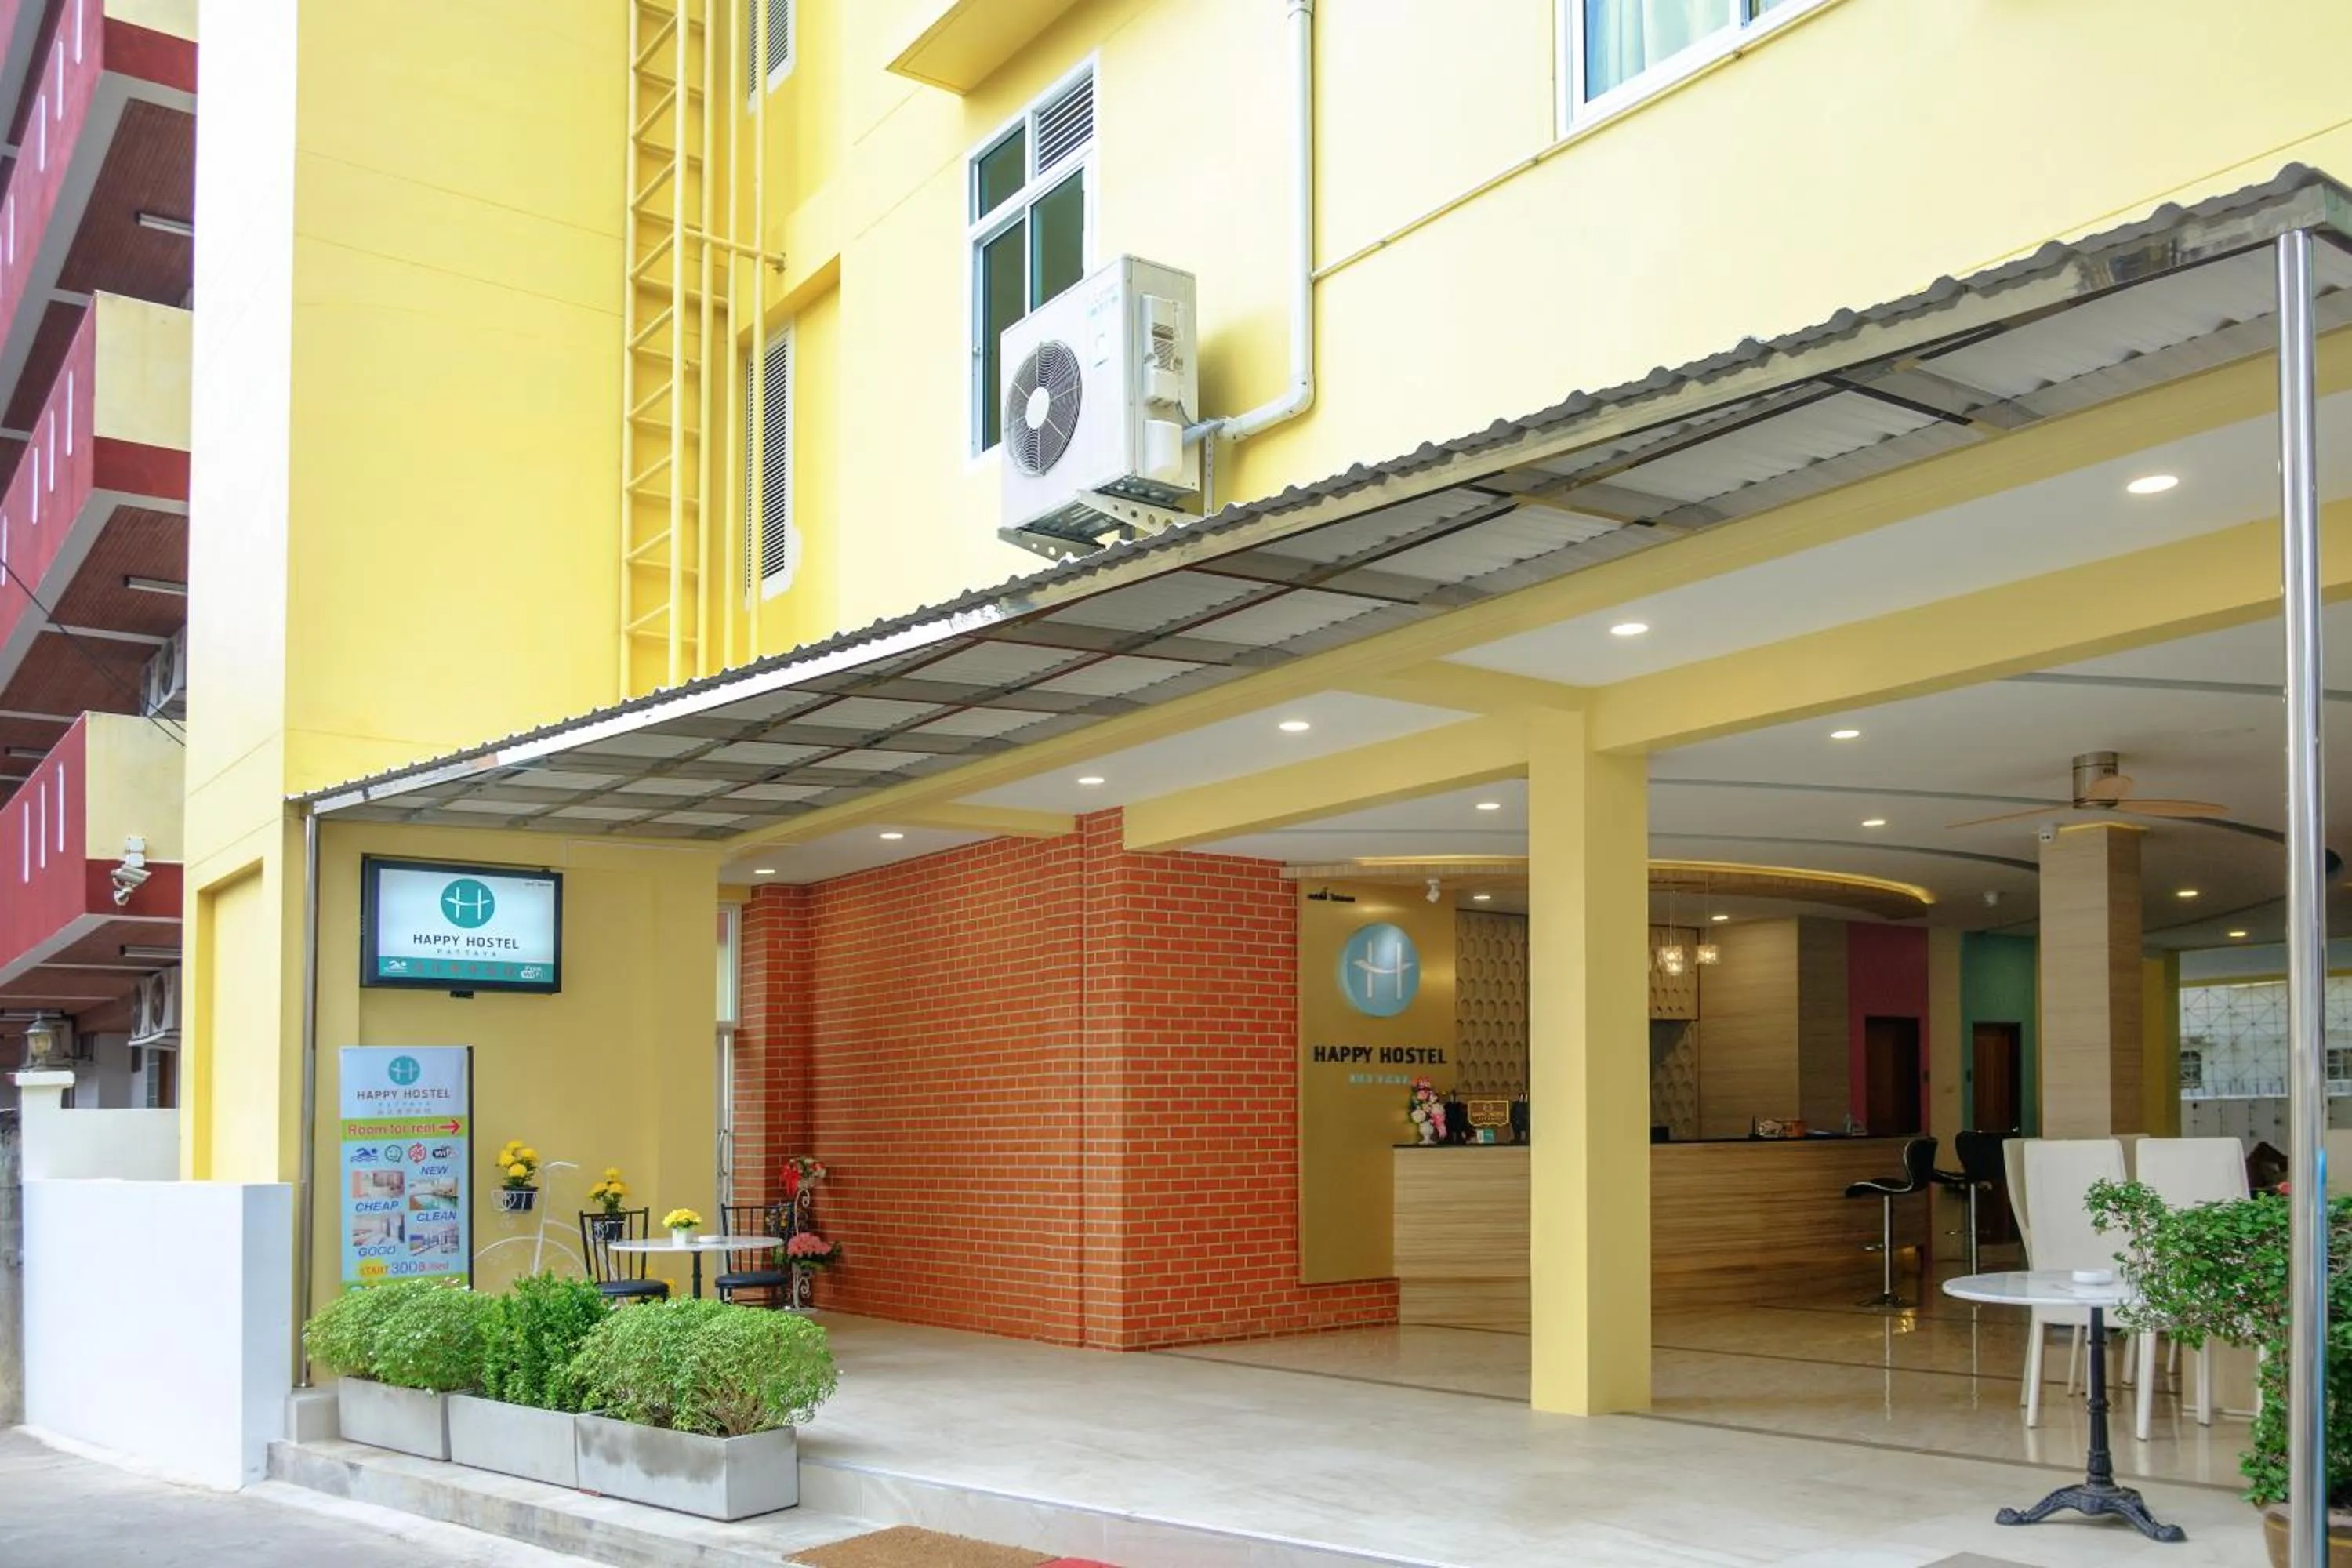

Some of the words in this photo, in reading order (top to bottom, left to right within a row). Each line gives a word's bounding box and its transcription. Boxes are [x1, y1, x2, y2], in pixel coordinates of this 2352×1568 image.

[413, 934, 460, 946] HAPPY
[466, 937, 520, 949] HOSTEL
[1313, 1045, 1374, 1065] HAPPY
[1379, 1047, 1448, 1065] HOSTEL
[357, 1090, 398, 1100] HAPPY
[404, 1089, 451, 1099] HOSTEL
[348, 1123, 387, 1135] Room
[390, 1124, 407, 1134] for
[412, 1123, 436, 1134] rent
[420, 1166, 450, 1175] NEW
[355, 1201, 400, 1213] CHEAP
[416, 1210, 457, 1221] CLEAN
[358, 1246, 397, 1258] GOOD
